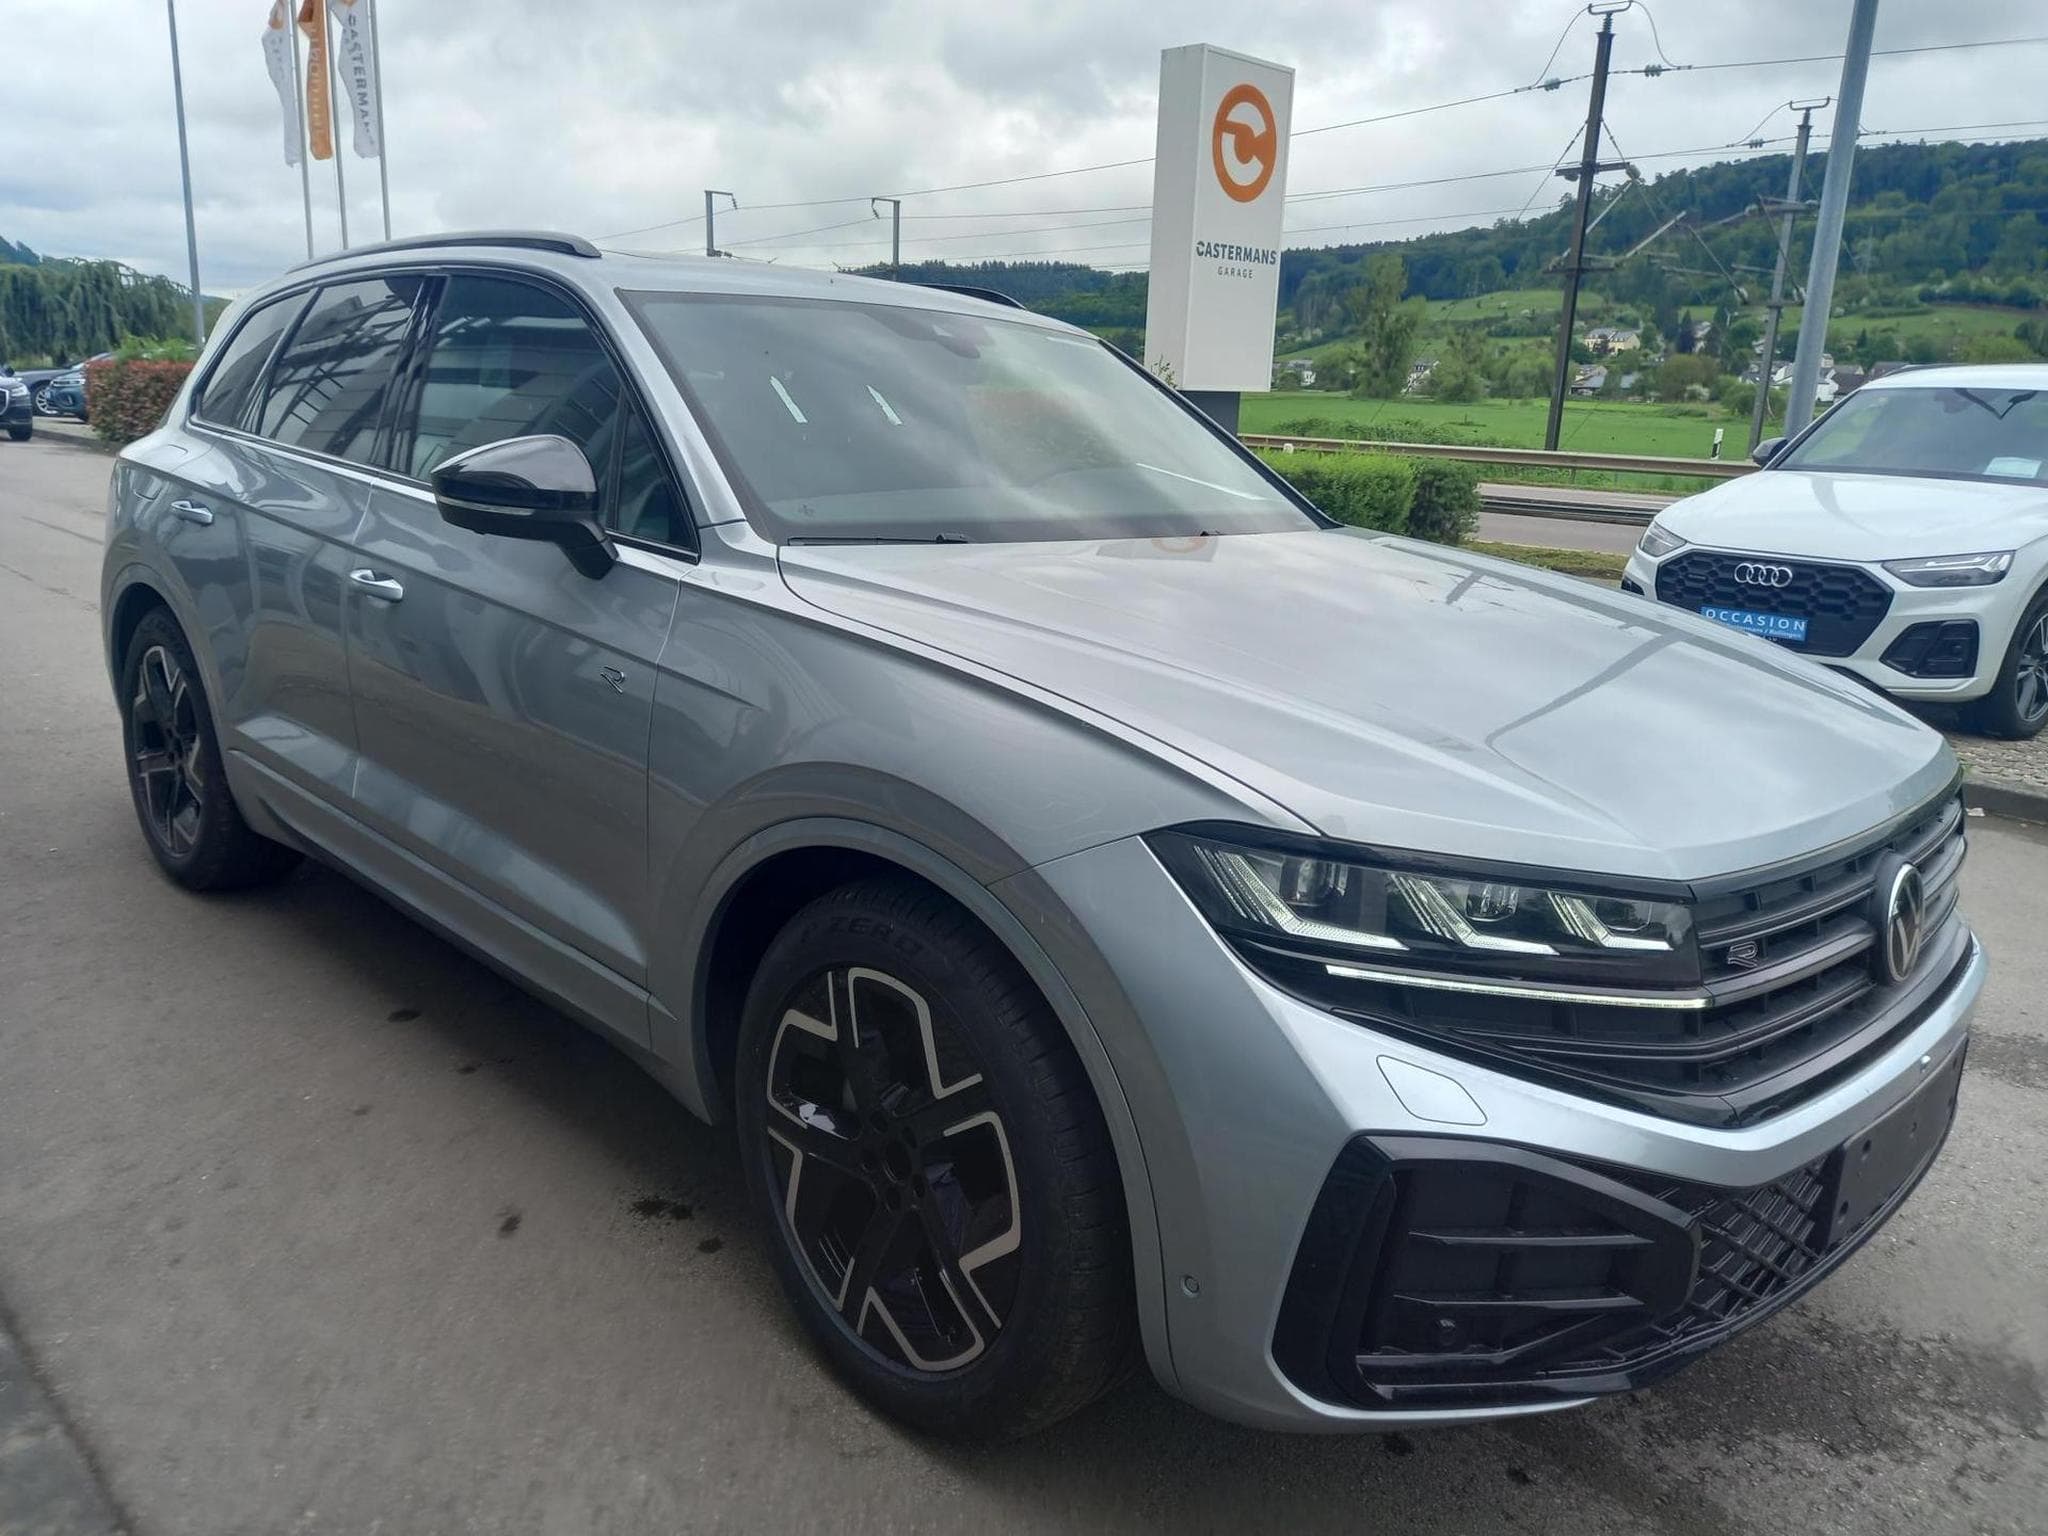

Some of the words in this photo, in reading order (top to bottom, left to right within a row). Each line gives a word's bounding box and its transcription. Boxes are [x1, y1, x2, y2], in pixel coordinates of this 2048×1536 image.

[1197, 241, 1276, 265] CASTERMANS
[1218, 266, 1253, 278] GARAGE
[1706, 609, 1805, 630] OCCASION
